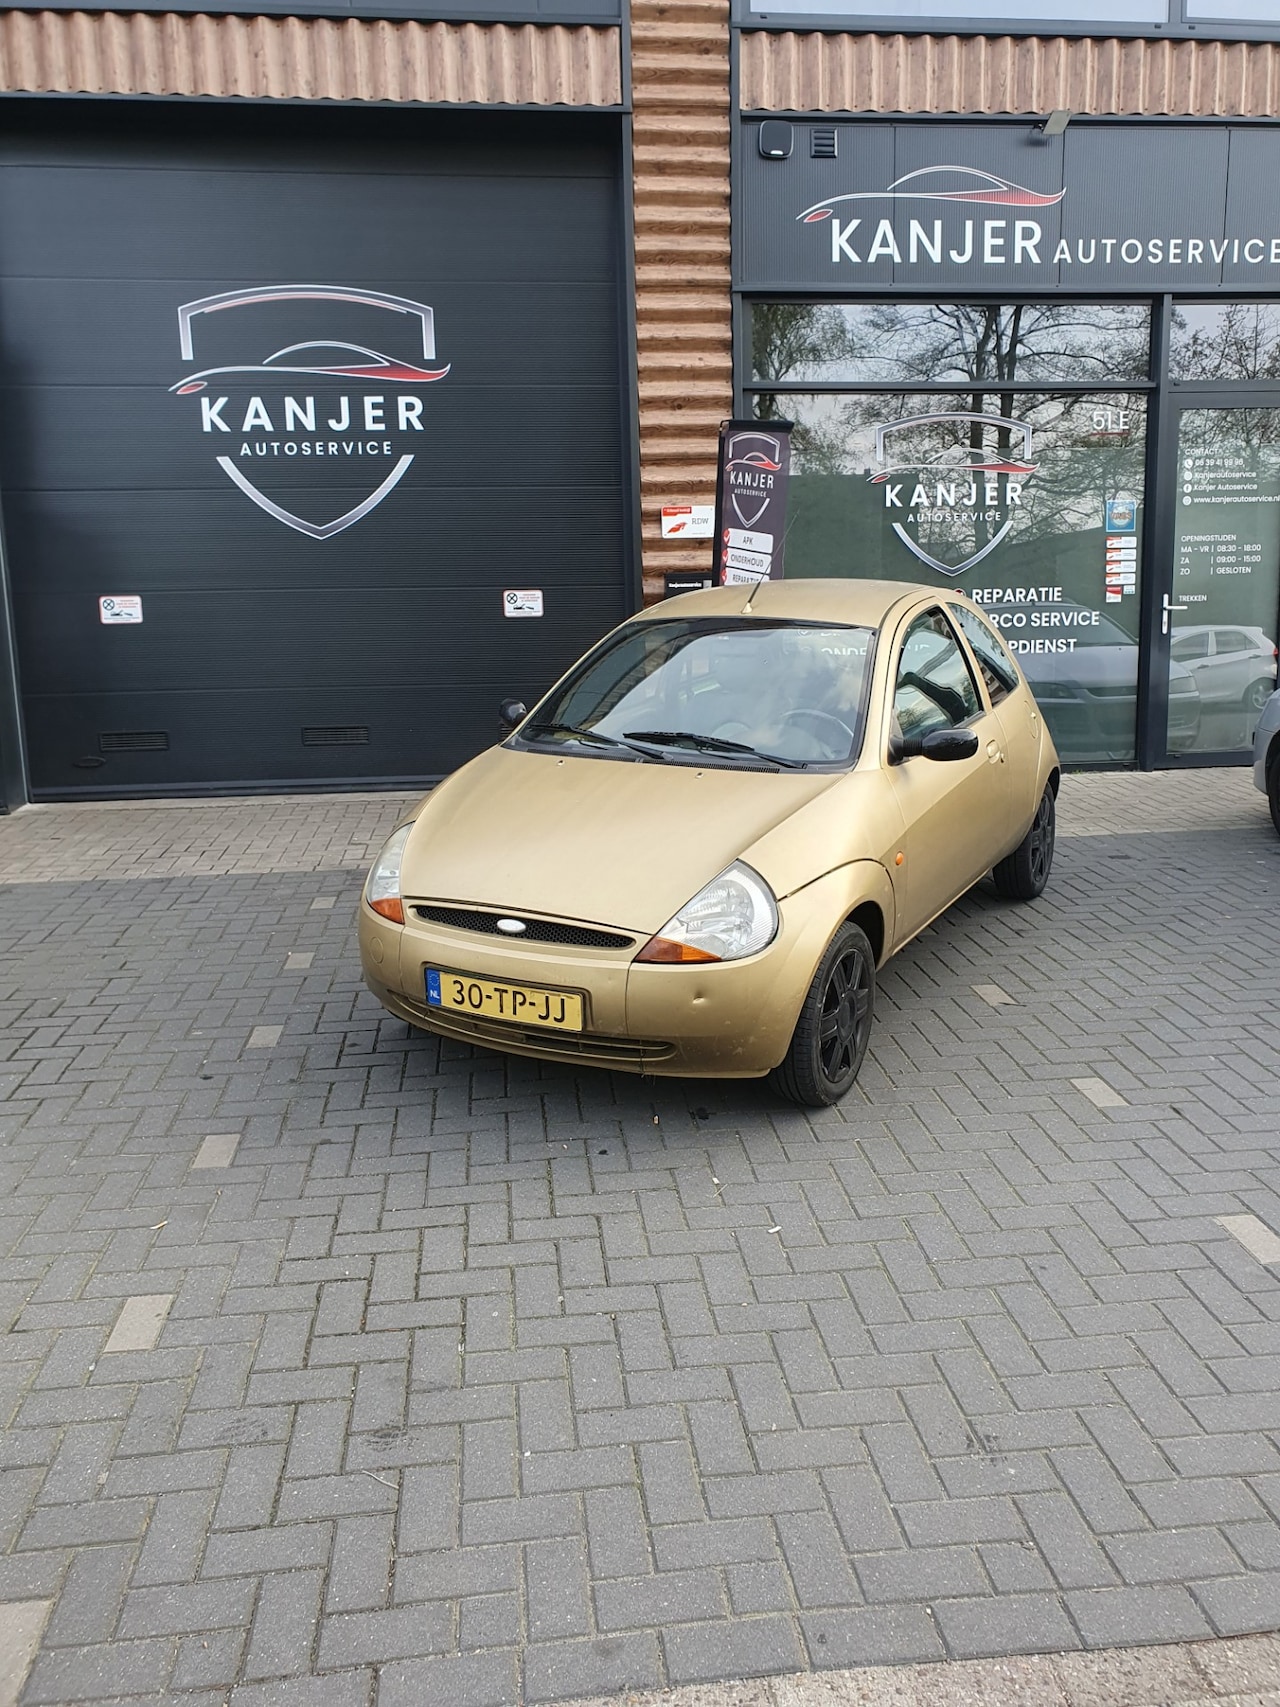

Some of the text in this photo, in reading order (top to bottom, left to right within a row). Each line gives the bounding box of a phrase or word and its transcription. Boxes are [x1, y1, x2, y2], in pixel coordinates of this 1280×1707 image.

[831, 219, 1280, 264] KANJER AUTOSERVICE
[200, 396, 425, 432] KANJER
[239, 440, 393, 456] AUTOSERVICE
[730, 470, 774, 489] KANJER
[734, 488, 767, 498] AUTOSERVICE
[884, 483, 1023, 508] KANJER
[691, 517, 709, 525] RDW
[907, 511, 1001, 523] AUTOSERVICE
[742, 536, 754, 545] APK
[1180, 545, 1192, 553] MA
[1199, 545, 1209, 553] VR
[730, 553, 764, 568] ONDERHOUD
[1216, 566, 1252, 574] GESLOTEN
[972, 587, 1063, 604] REPARATIE
[1178, 594, 1207, 602] TREKKEN
[988, 611, 1100, 628] RCO SERVICE
[1005, 638, 1078, 654] PDIENST
[429, 979, 566, 1023] NL 30-TP-JJ
